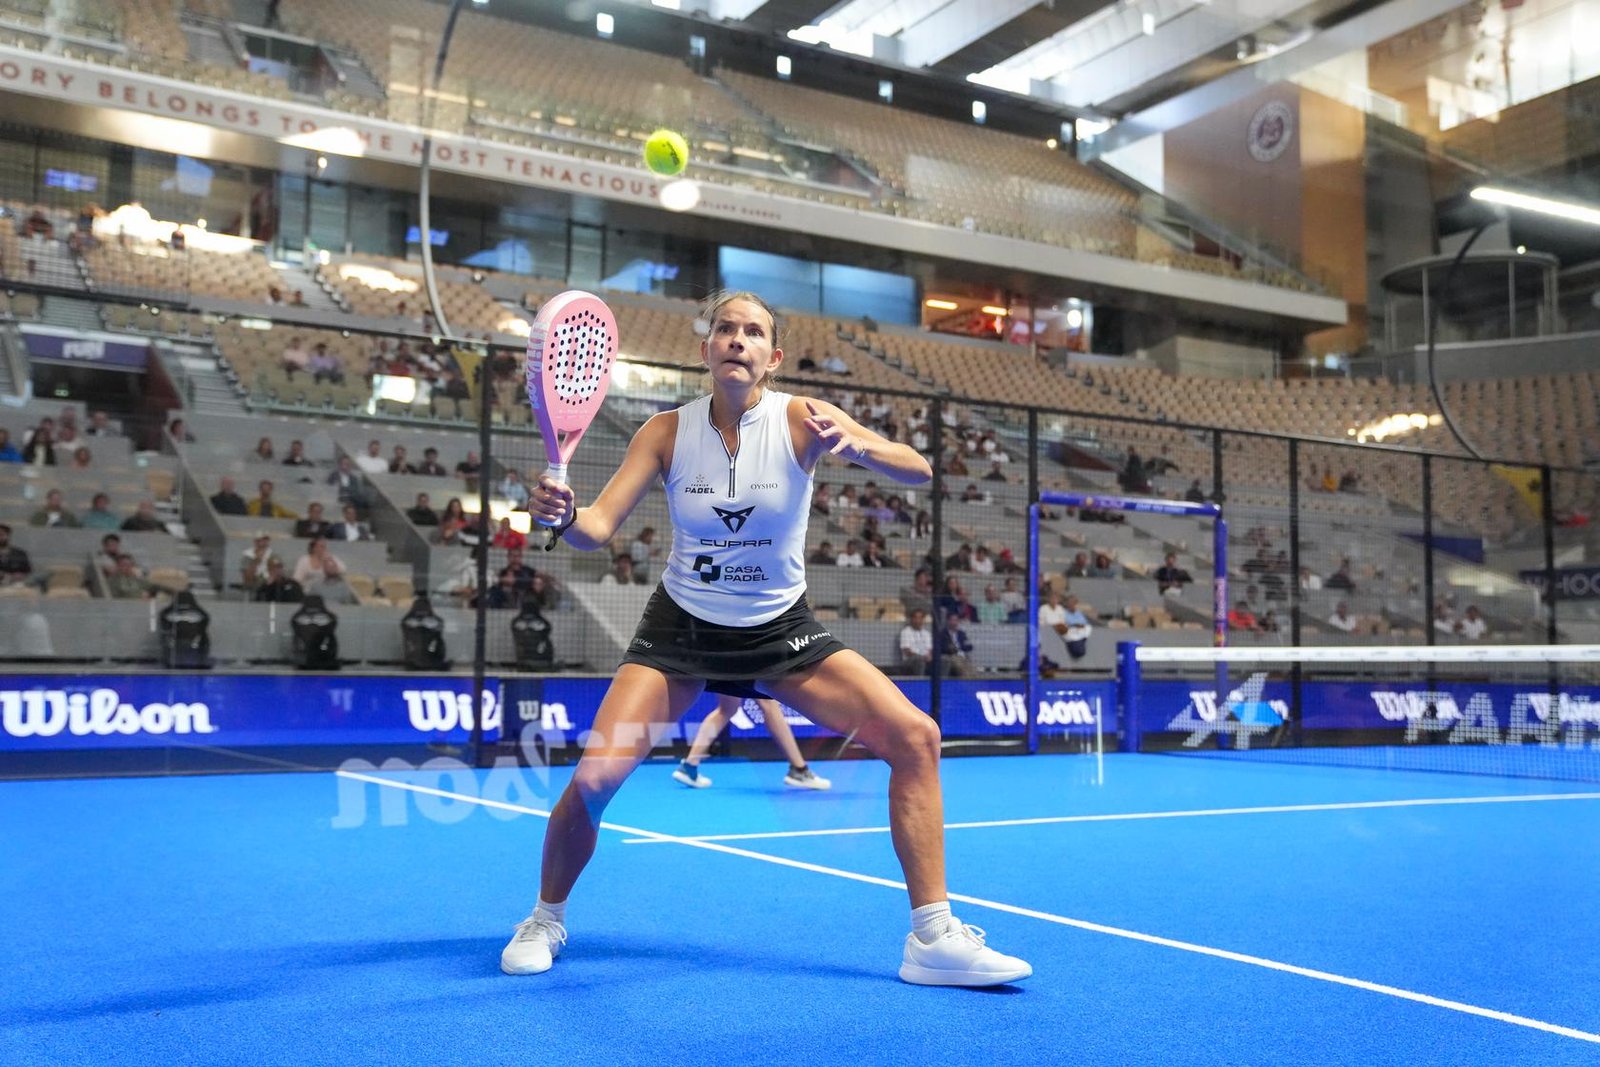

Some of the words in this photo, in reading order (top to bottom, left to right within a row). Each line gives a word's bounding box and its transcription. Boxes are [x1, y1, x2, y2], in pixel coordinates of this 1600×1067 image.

[0, 62, 74, 91] ORY
[98, 80, 261, 127] BELONGS
[281, 116, 317, 134] TO
[504, 156, 660, 199] TENACIOUS
[750, 482, 779, 491] OYSHO
[700, 538, 773, 548] CUPRA
[724, 566, 763, 574] CASA
[724, 573, 770, 582] PADEL
[0, 688, 216, 737] Wilson
[402, 689, 572, 732] Wiln
[976, 691, 1095, 725] Wison
